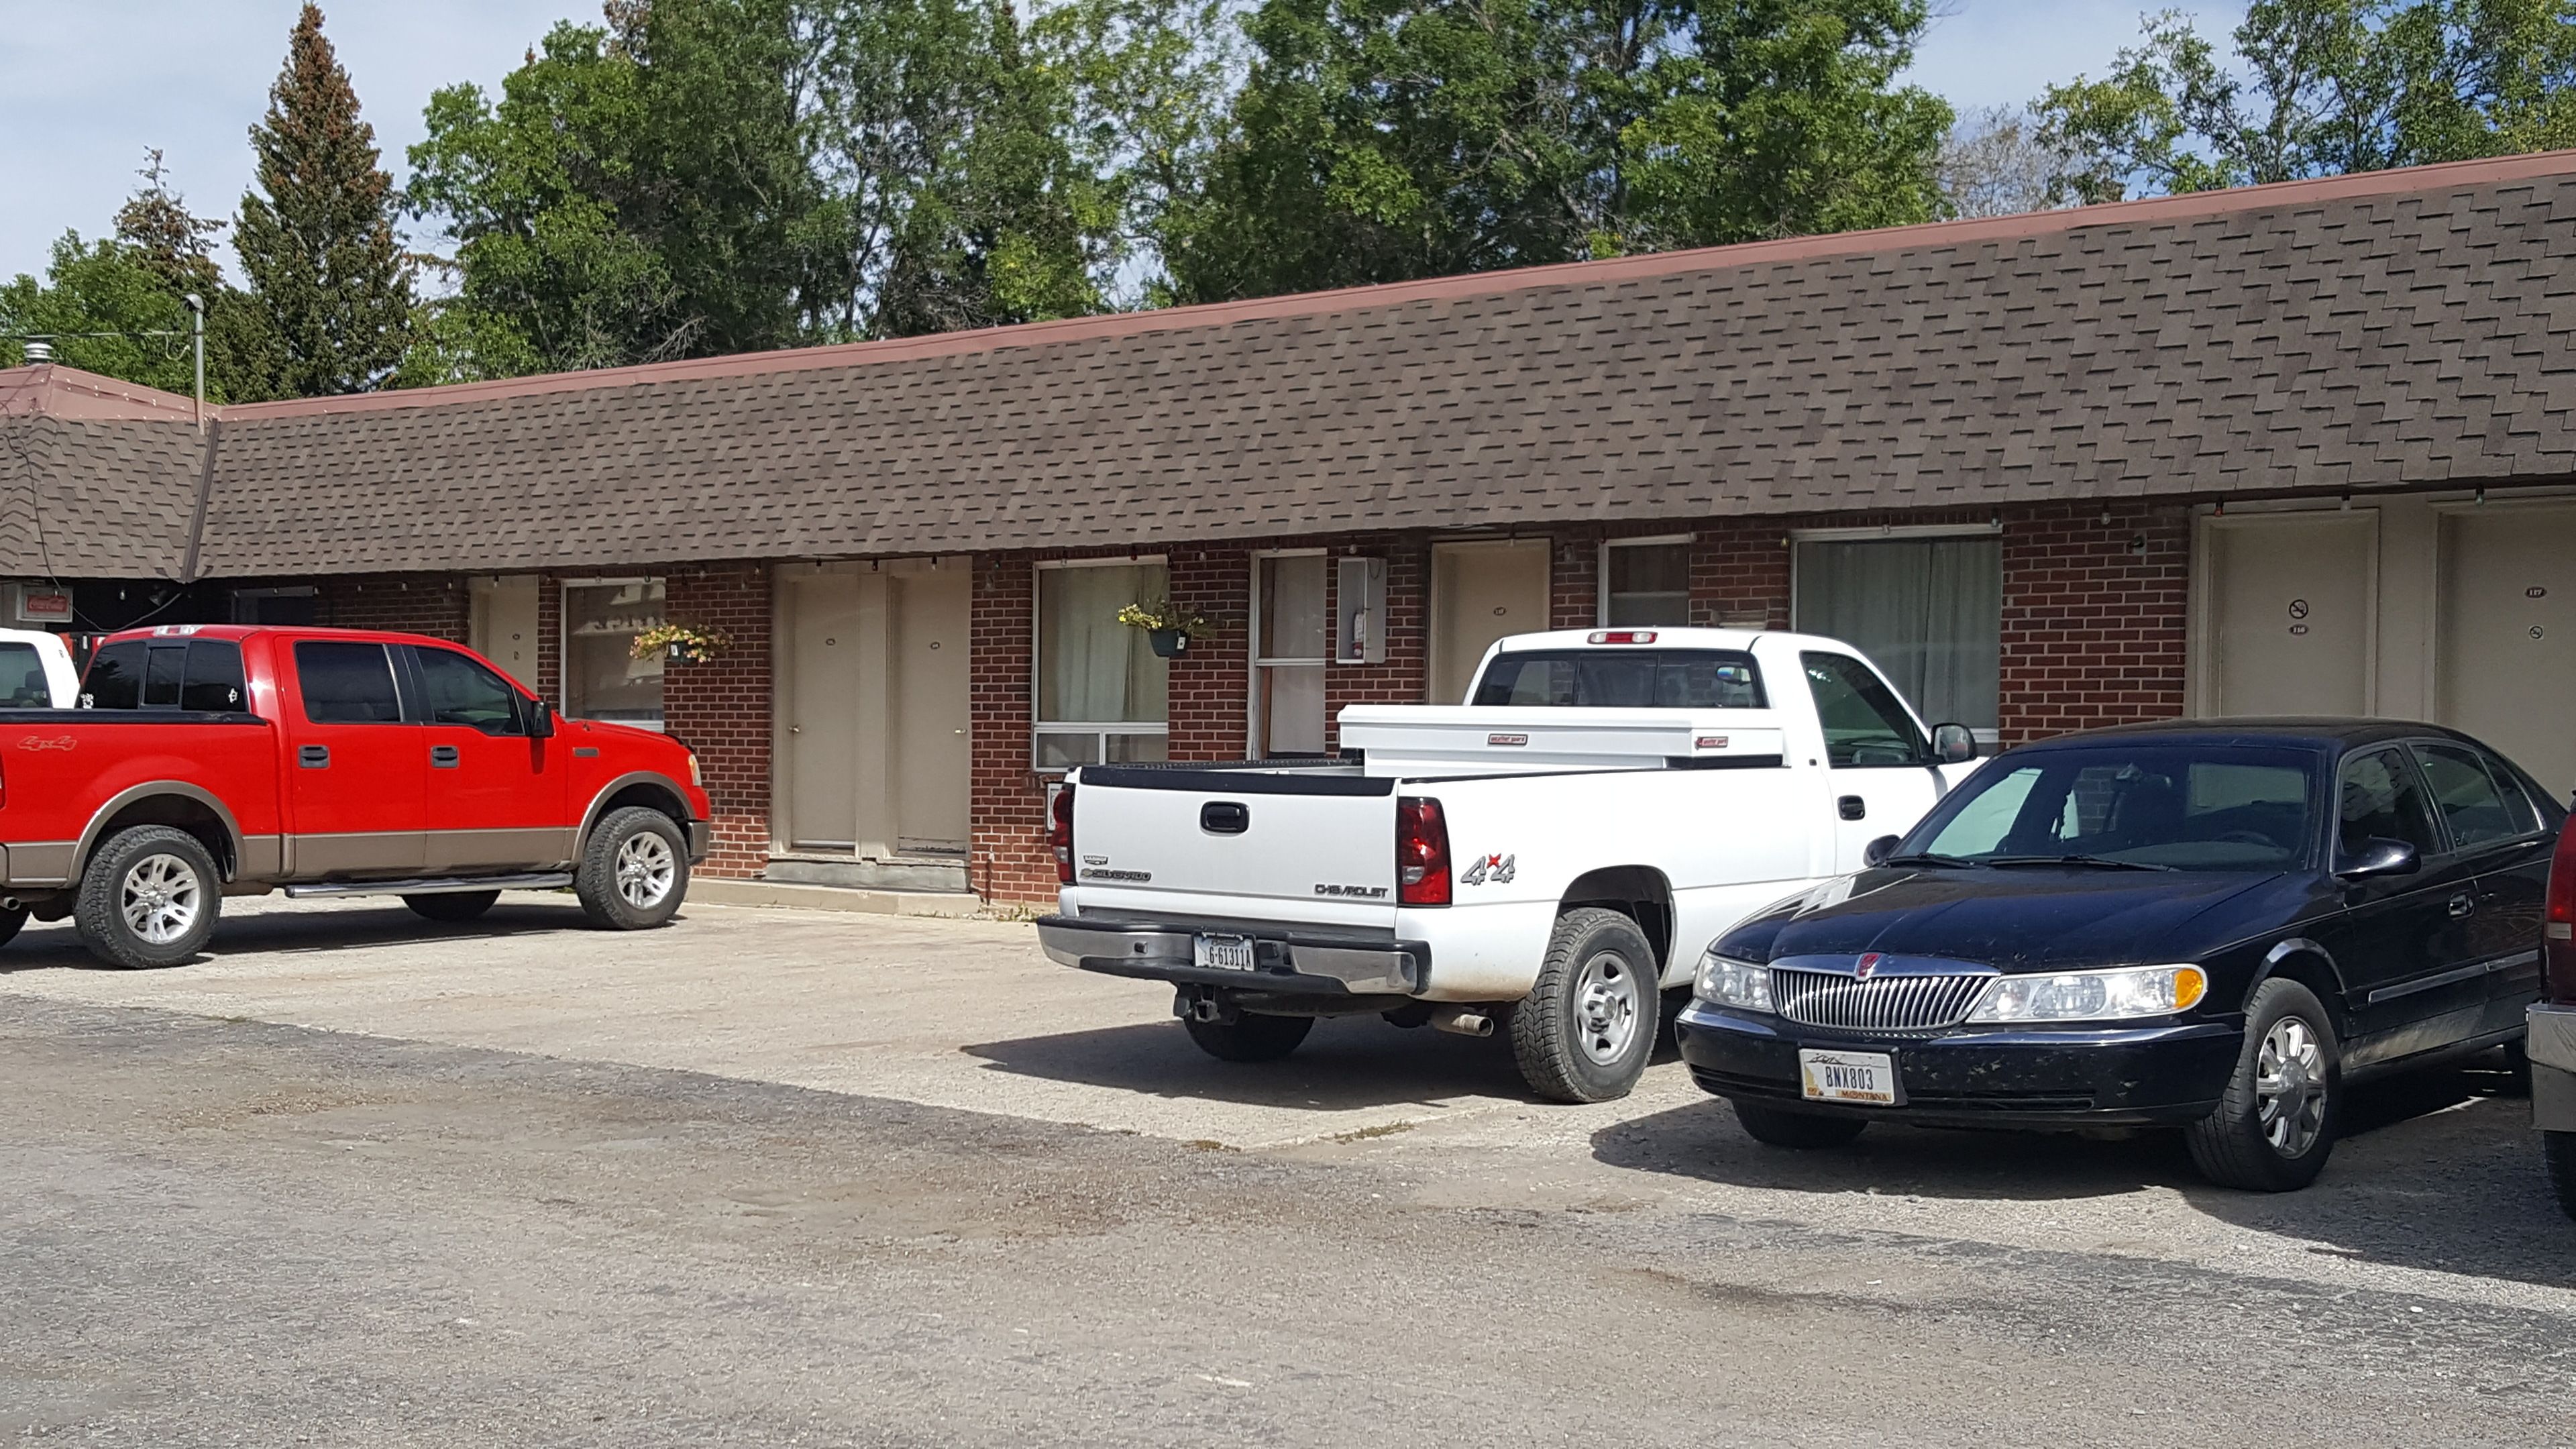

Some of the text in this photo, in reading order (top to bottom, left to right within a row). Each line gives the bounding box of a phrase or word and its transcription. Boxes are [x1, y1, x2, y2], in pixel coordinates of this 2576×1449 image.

[1093, 869, 1151, 881] SILVERADO
[1315, 884, 1388, 898] CHEVROLET
[1825, 1065, 1874, 1090] BNX803
[1841, 1089, 1890, 1102] MONTANA
